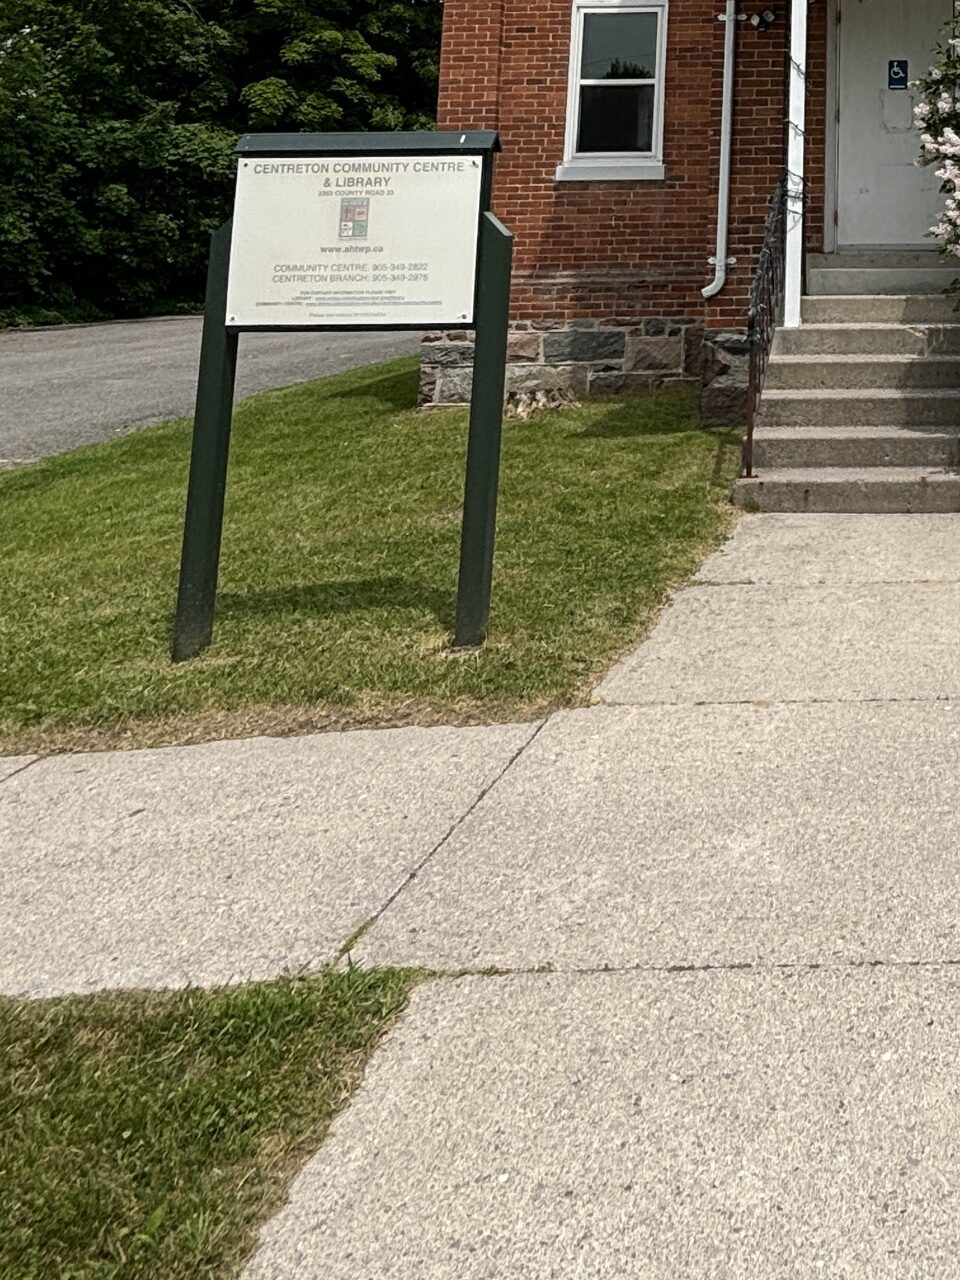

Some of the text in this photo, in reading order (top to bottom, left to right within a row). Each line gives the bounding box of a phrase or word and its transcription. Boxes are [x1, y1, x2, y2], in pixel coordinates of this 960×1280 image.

[254, 161, 464, 174] CENTRETON COMMUNITY CENTRE
[323, 176, 391, 188] & LIBRARY
[274, 263, 329, 272] COMMUNITY
[272, 274, 328, 283] CENTRETON
